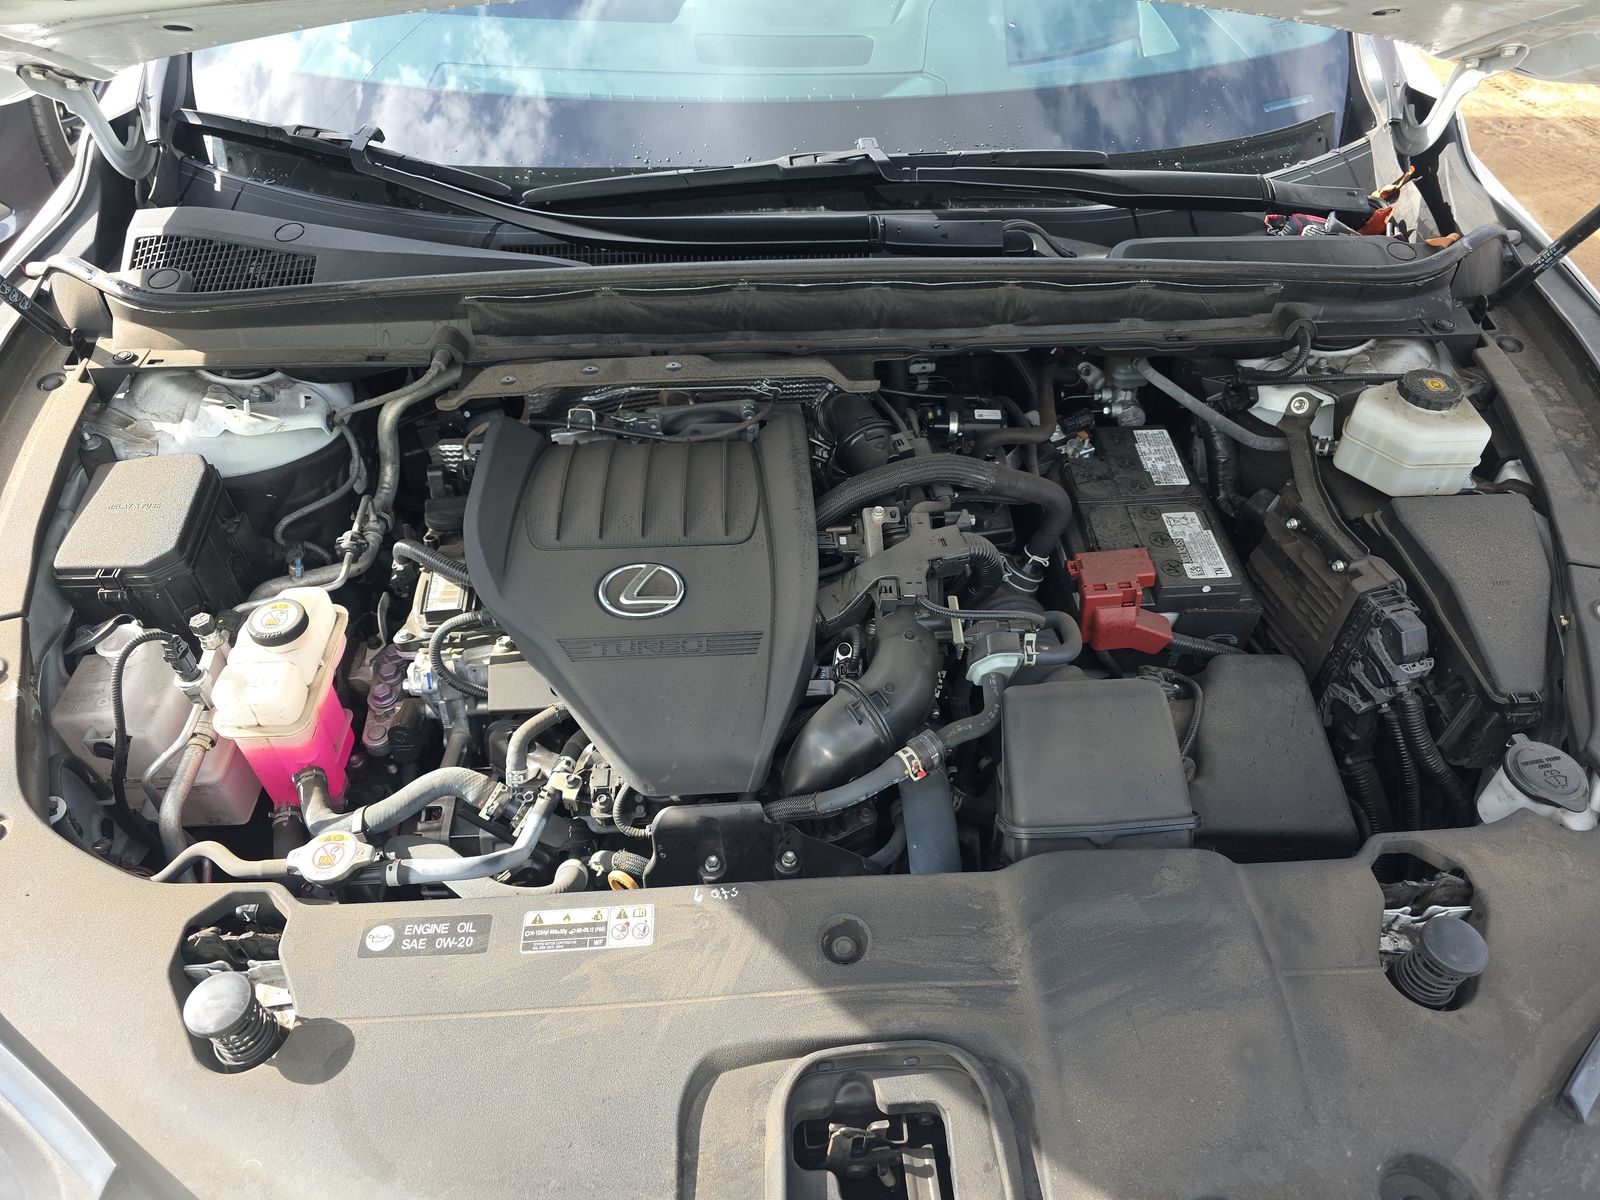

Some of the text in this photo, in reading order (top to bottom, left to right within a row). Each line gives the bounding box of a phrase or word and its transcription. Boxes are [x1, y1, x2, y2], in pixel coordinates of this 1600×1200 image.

[592, 638, 702, 656] TURBO
[403, 922, 477, 935] ENGINE OIL
[401, 936, 473, 950] SAE 0W-20
